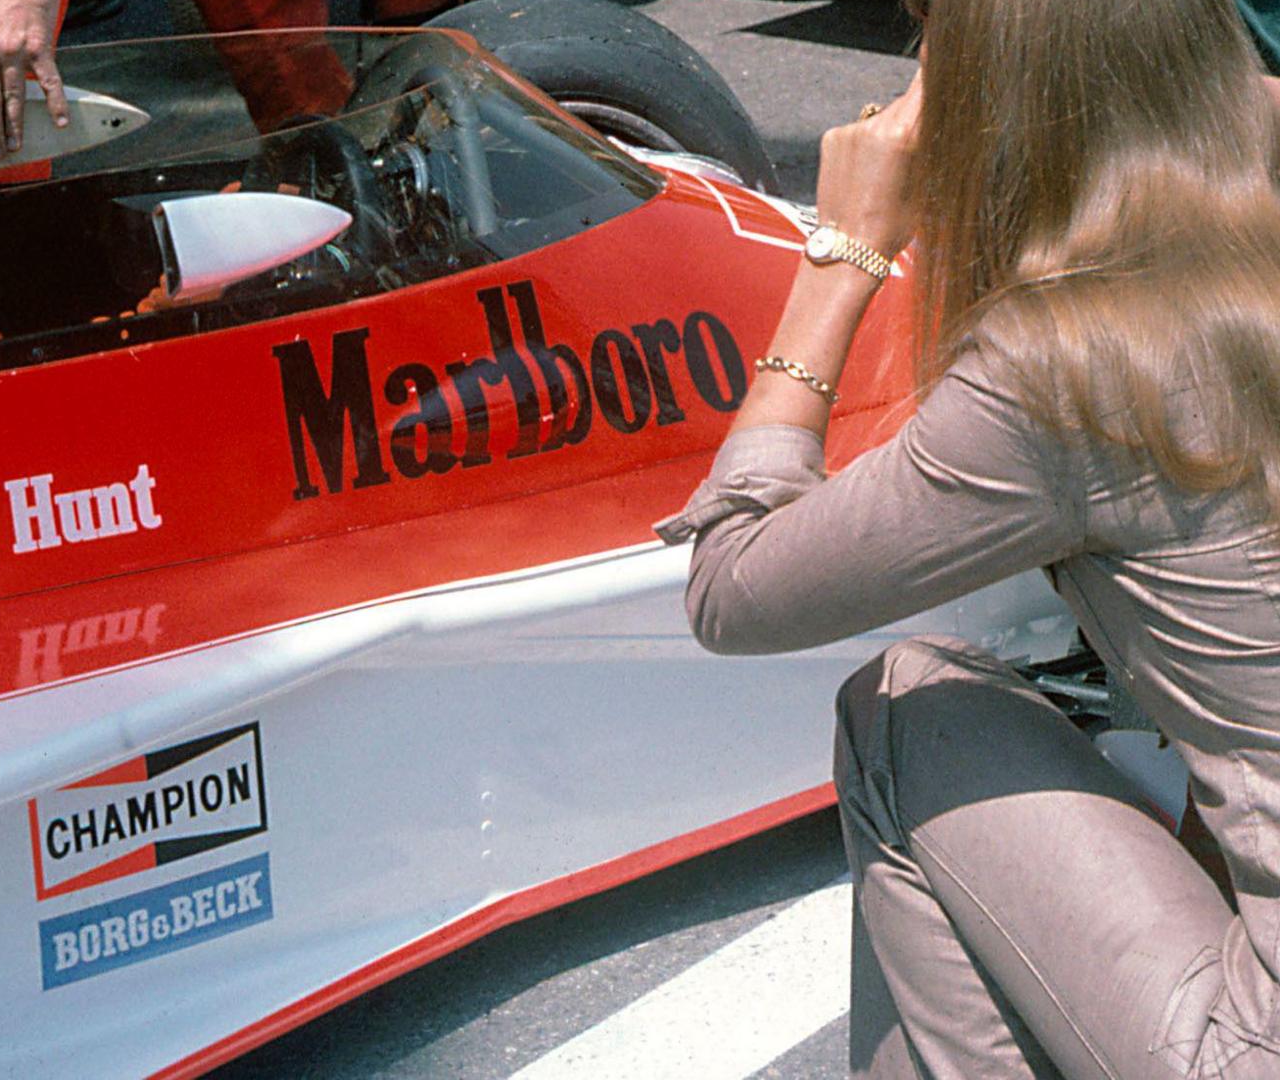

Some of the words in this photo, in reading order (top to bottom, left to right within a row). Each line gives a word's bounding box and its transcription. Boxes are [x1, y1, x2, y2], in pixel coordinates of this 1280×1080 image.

[272, 280, 749, 502] Marlboro
[4, 464, 163, 554] Hunt
[46, 762, 252, 860] CHAMPION
